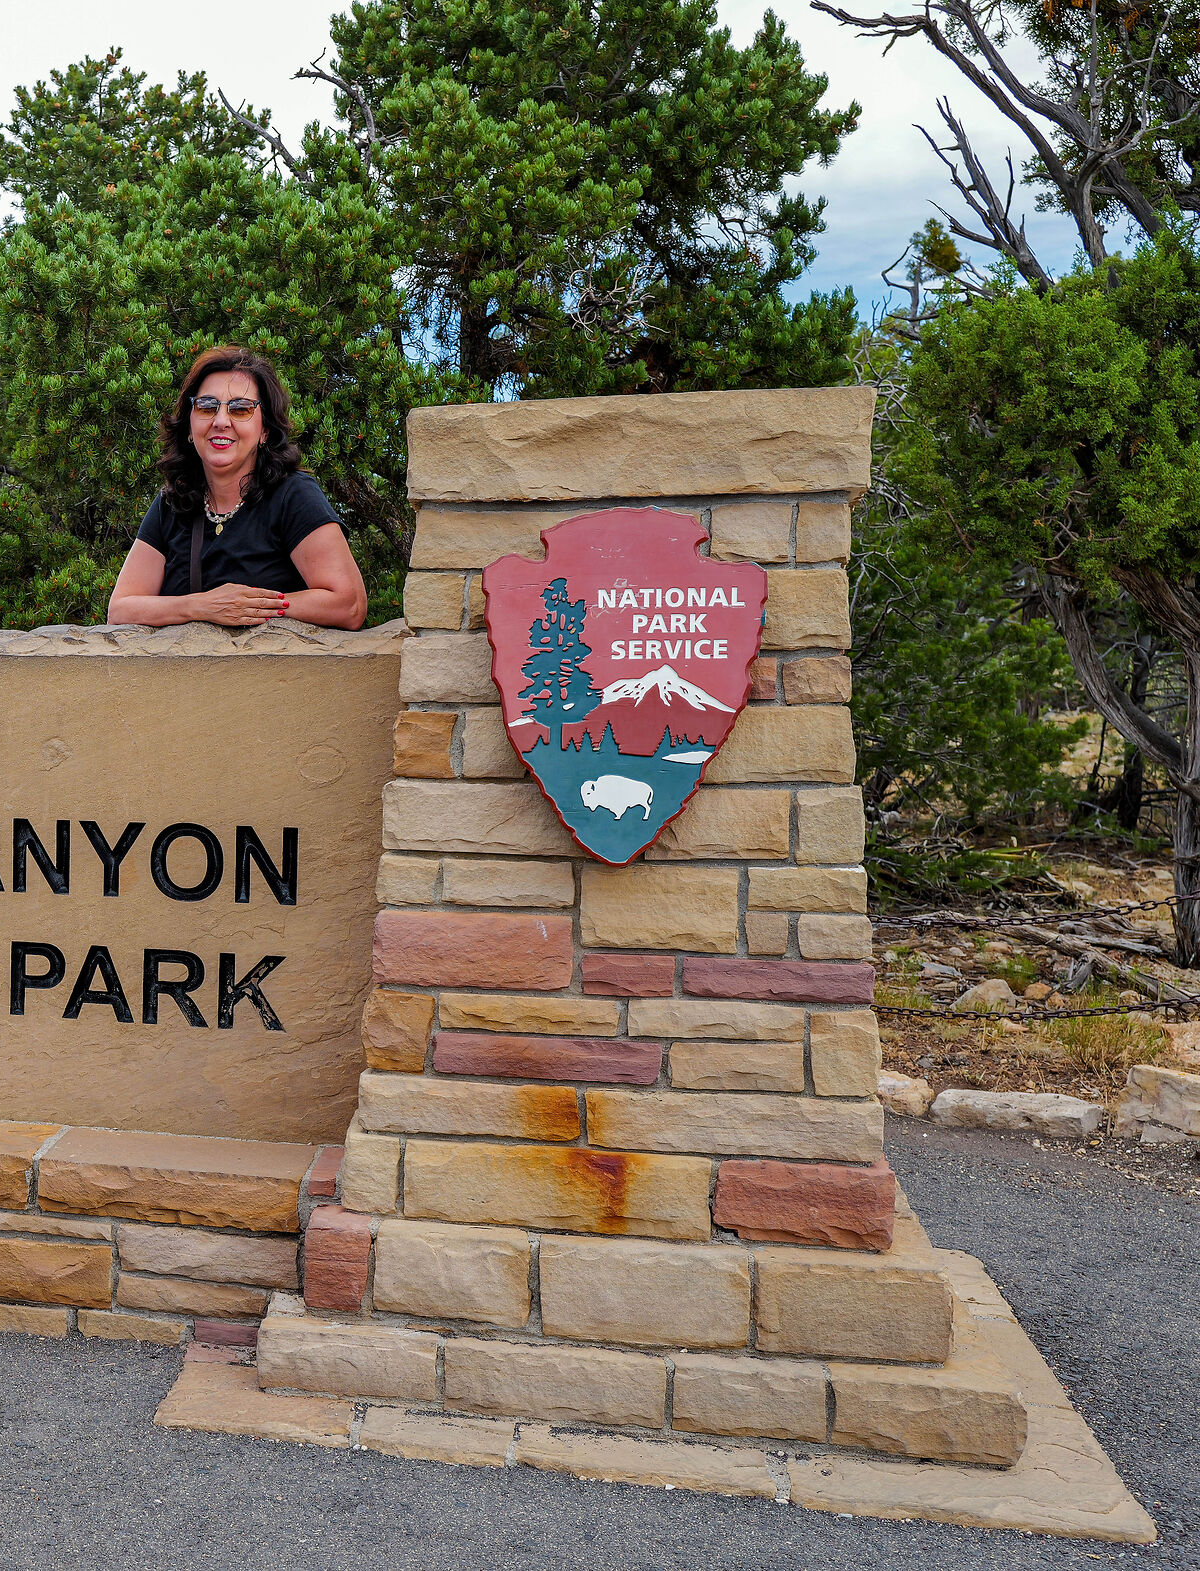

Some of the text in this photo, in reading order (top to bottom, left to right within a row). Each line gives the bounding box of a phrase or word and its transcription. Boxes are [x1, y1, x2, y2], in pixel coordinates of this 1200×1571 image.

[597, 586, 746, 609] NATIONAL
[632, 613, 708, 634] PARK
[610, 639, 729, 660] SERVICE
[9, 940, 287, 1033] PARK
